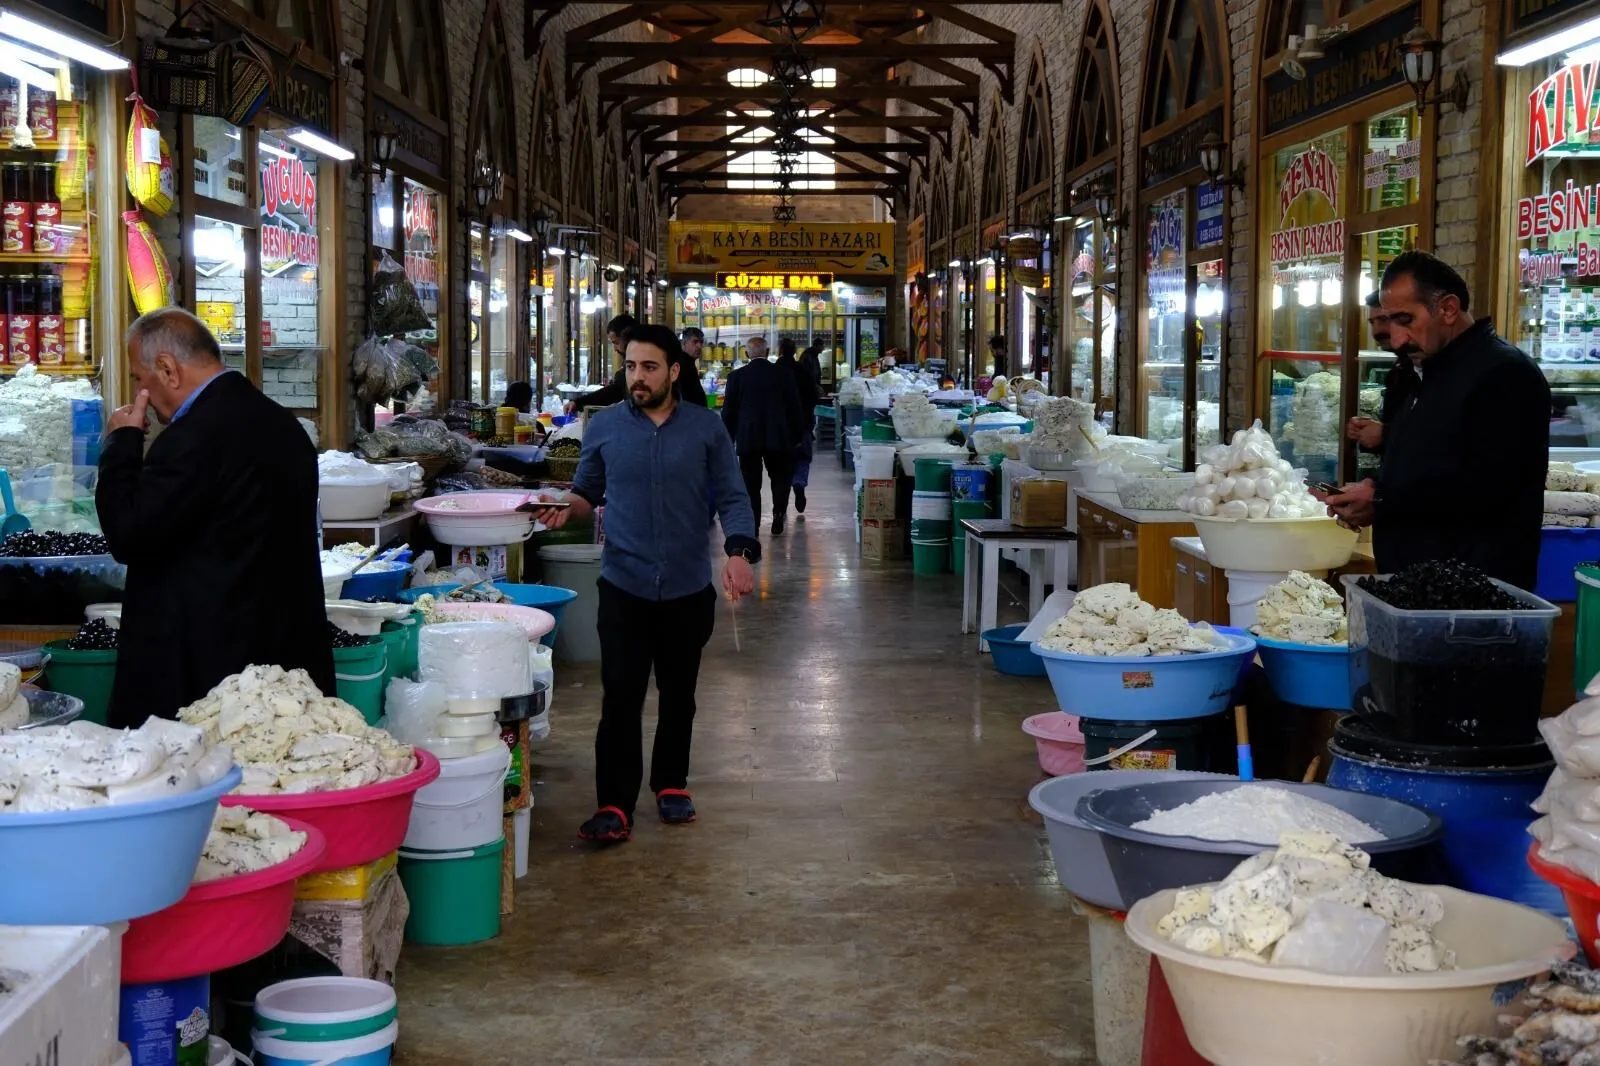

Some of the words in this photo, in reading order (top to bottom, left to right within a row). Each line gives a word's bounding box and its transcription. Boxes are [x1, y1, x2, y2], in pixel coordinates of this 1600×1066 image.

[1526, 58, 1600, 168] KIV
[1280, 150, 1339, 230] KENAN
[1516, 178, 1591, 240] BESİN
[261, 220, 290, 259] BESİN
[713, 231, 762, 249] KAYA
[768, 227, 814, 249] BESİN
[819, 231, 881, 249] PAZARI
[1270, 216, 1303, 264] BESİN
[725, 272, 785, 289] SÜZME
[789, 275, 823, 289] BAL
[1519, 249, 1563, 288] Peynir
